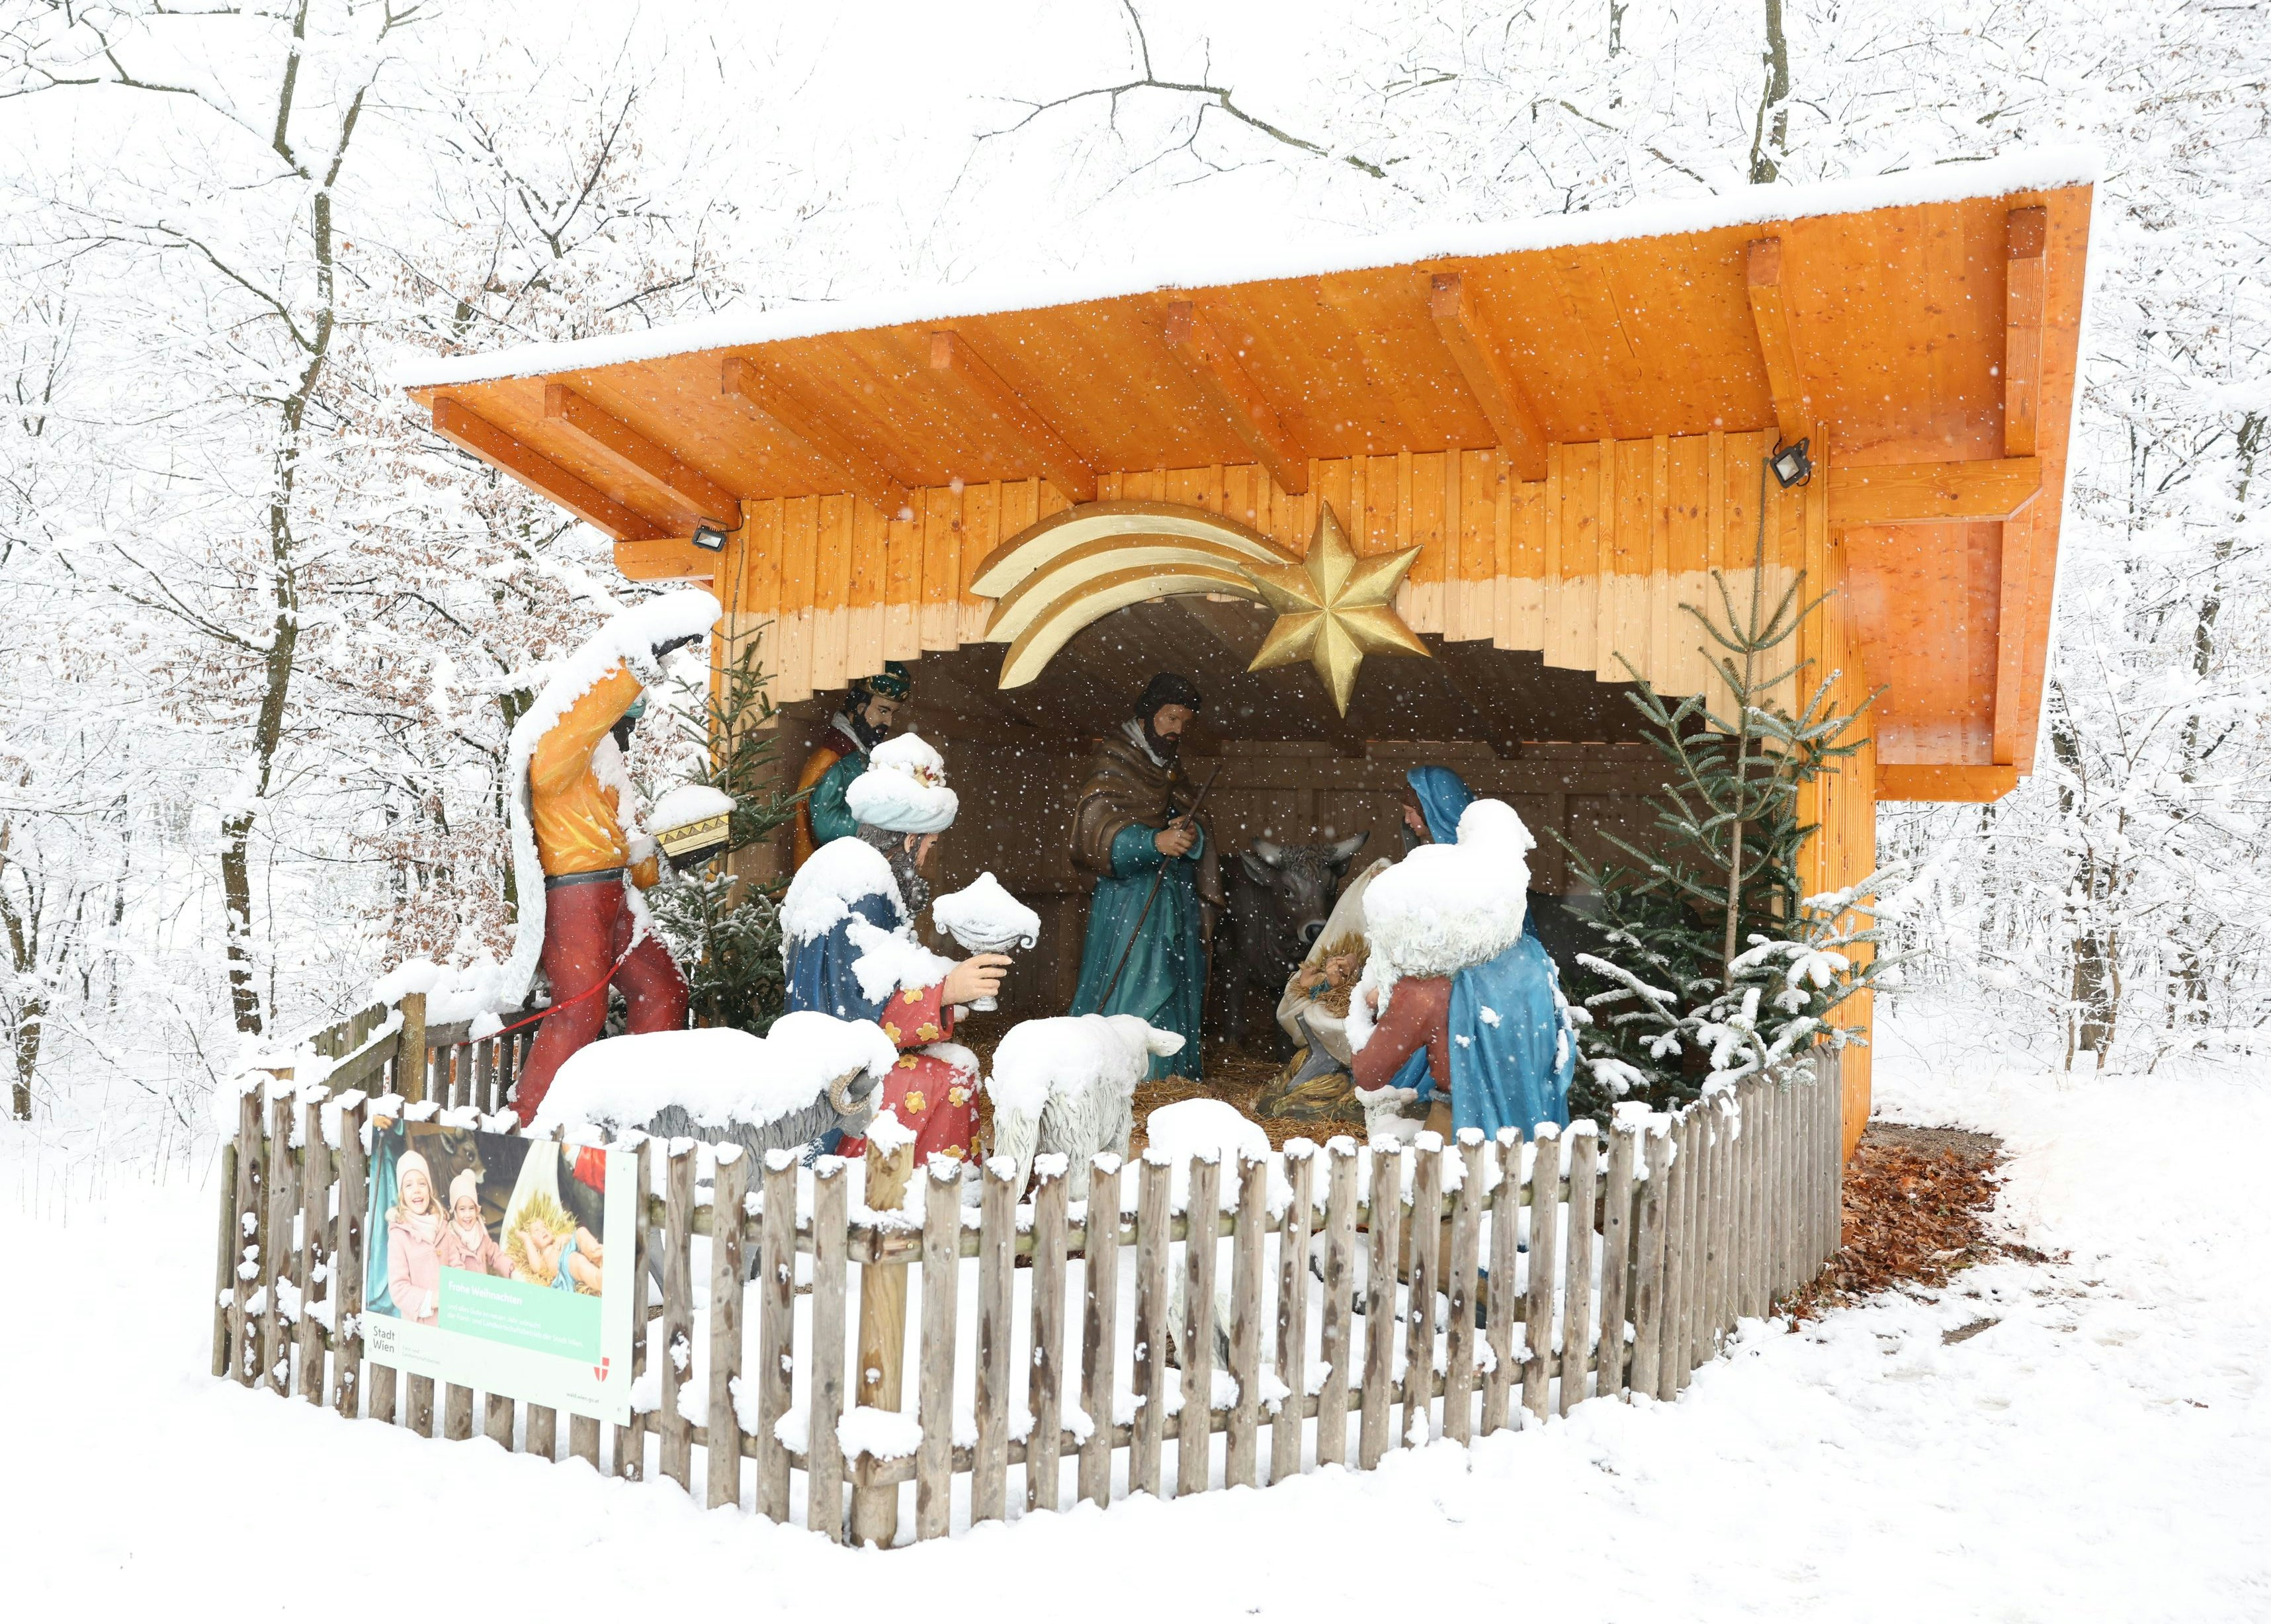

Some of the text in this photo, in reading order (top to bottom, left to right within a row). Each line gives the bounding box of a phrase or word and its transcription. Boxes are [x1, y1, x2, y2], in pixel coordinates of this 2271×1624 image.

[449, 1281, 523, 1306] Frohe Weihnachten
[373, 1326, 395, 1341] Stadt
[373, 1338, 394, 1353] Wien
